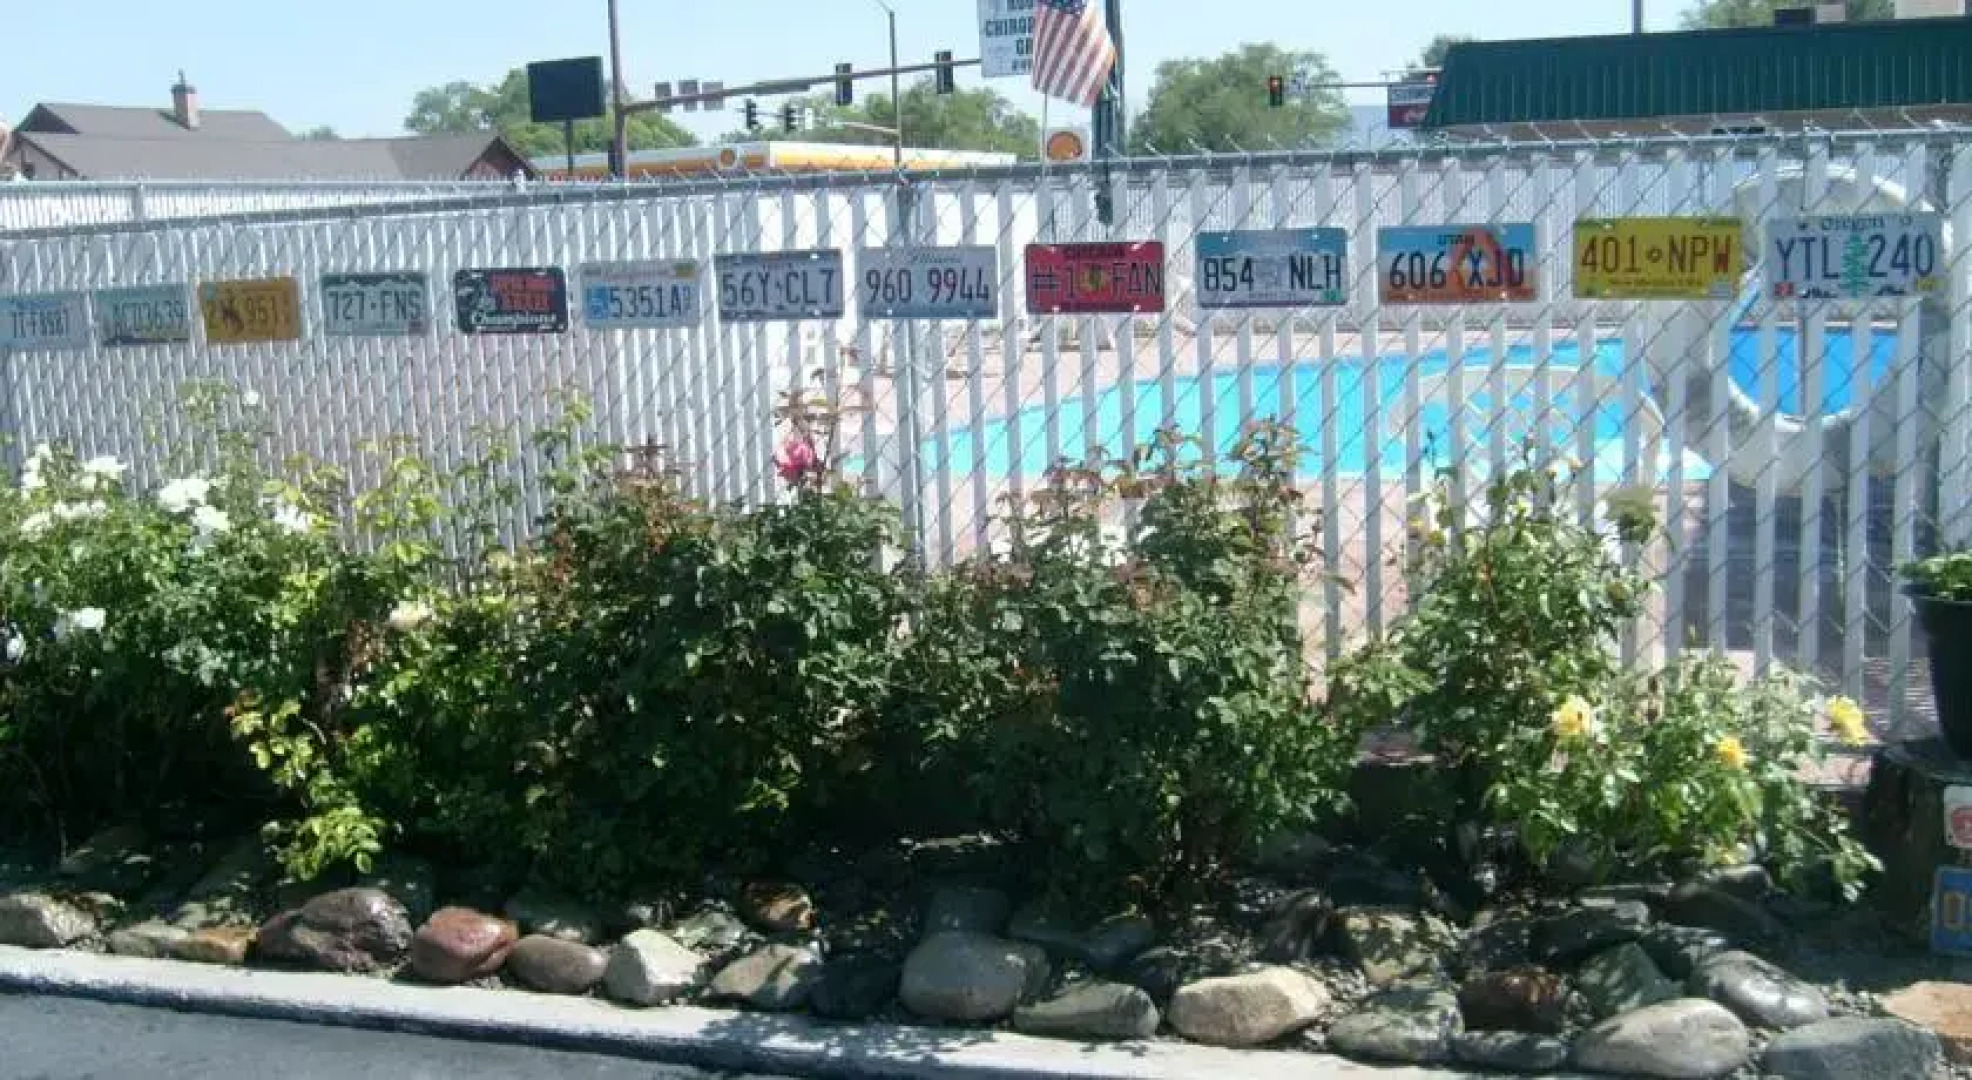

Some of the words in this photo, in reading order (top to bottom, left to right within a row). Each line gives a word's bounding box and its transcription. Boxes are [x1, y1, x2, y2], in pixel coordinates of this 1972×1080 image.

[1204, 257, 1254, 291] 854
[1290, 254, 1342, 289] NLH
[1389, 250, 1447, 289] 606
[1581, 234, 1642, 273] 401
[1668, 234, 1731, 273] NPW
[1775, 236, 1840, 280] YTL
[1868, 231, 1935, 276] 240
[722, 271, 770, 306] 56Y
[786, 268, 834, 304] CL7
[865, 268, 911, 304] 960
[927, 267, 989, 304] 9944
[1112, 262, 1162, 294] FAN
